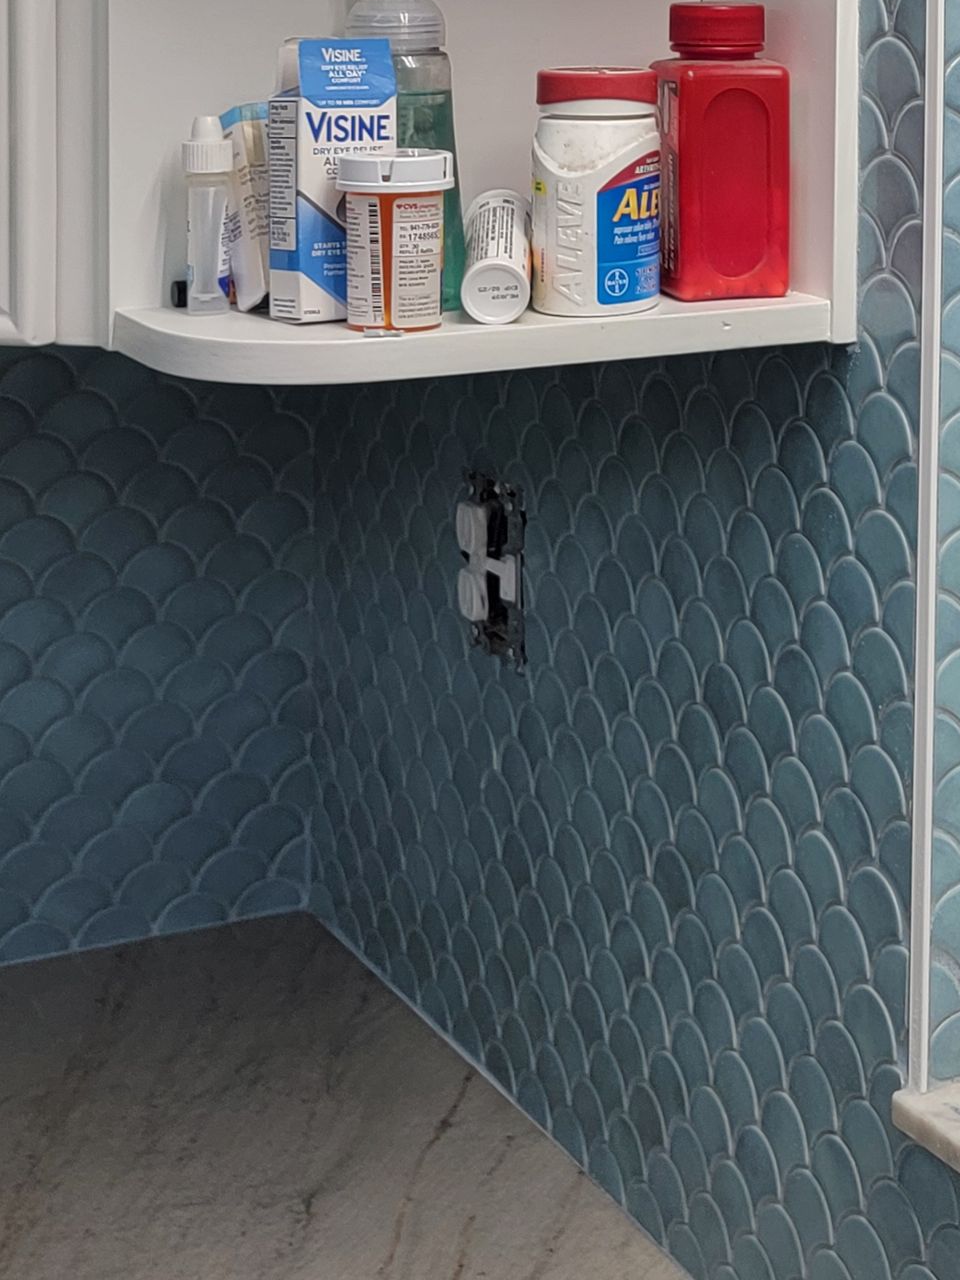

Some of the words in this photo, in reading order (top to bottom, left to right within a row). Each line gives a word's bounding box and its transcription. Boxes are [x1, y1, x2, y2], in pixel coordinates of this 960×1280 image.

[321, 48, 362, 62] VISINE
[329, 70, 345, 78] ALL
[305, 111, 391, 143] VISINE
[313, 147, 331, 155] DRY
[333, 146, 351, 155] EYE
[323, 156, 338, 166] AL
[612, 188, 660, 222] ALE
[552, 181, 584, 307] ALEVE
[668, 227, 676, 271] Extra
